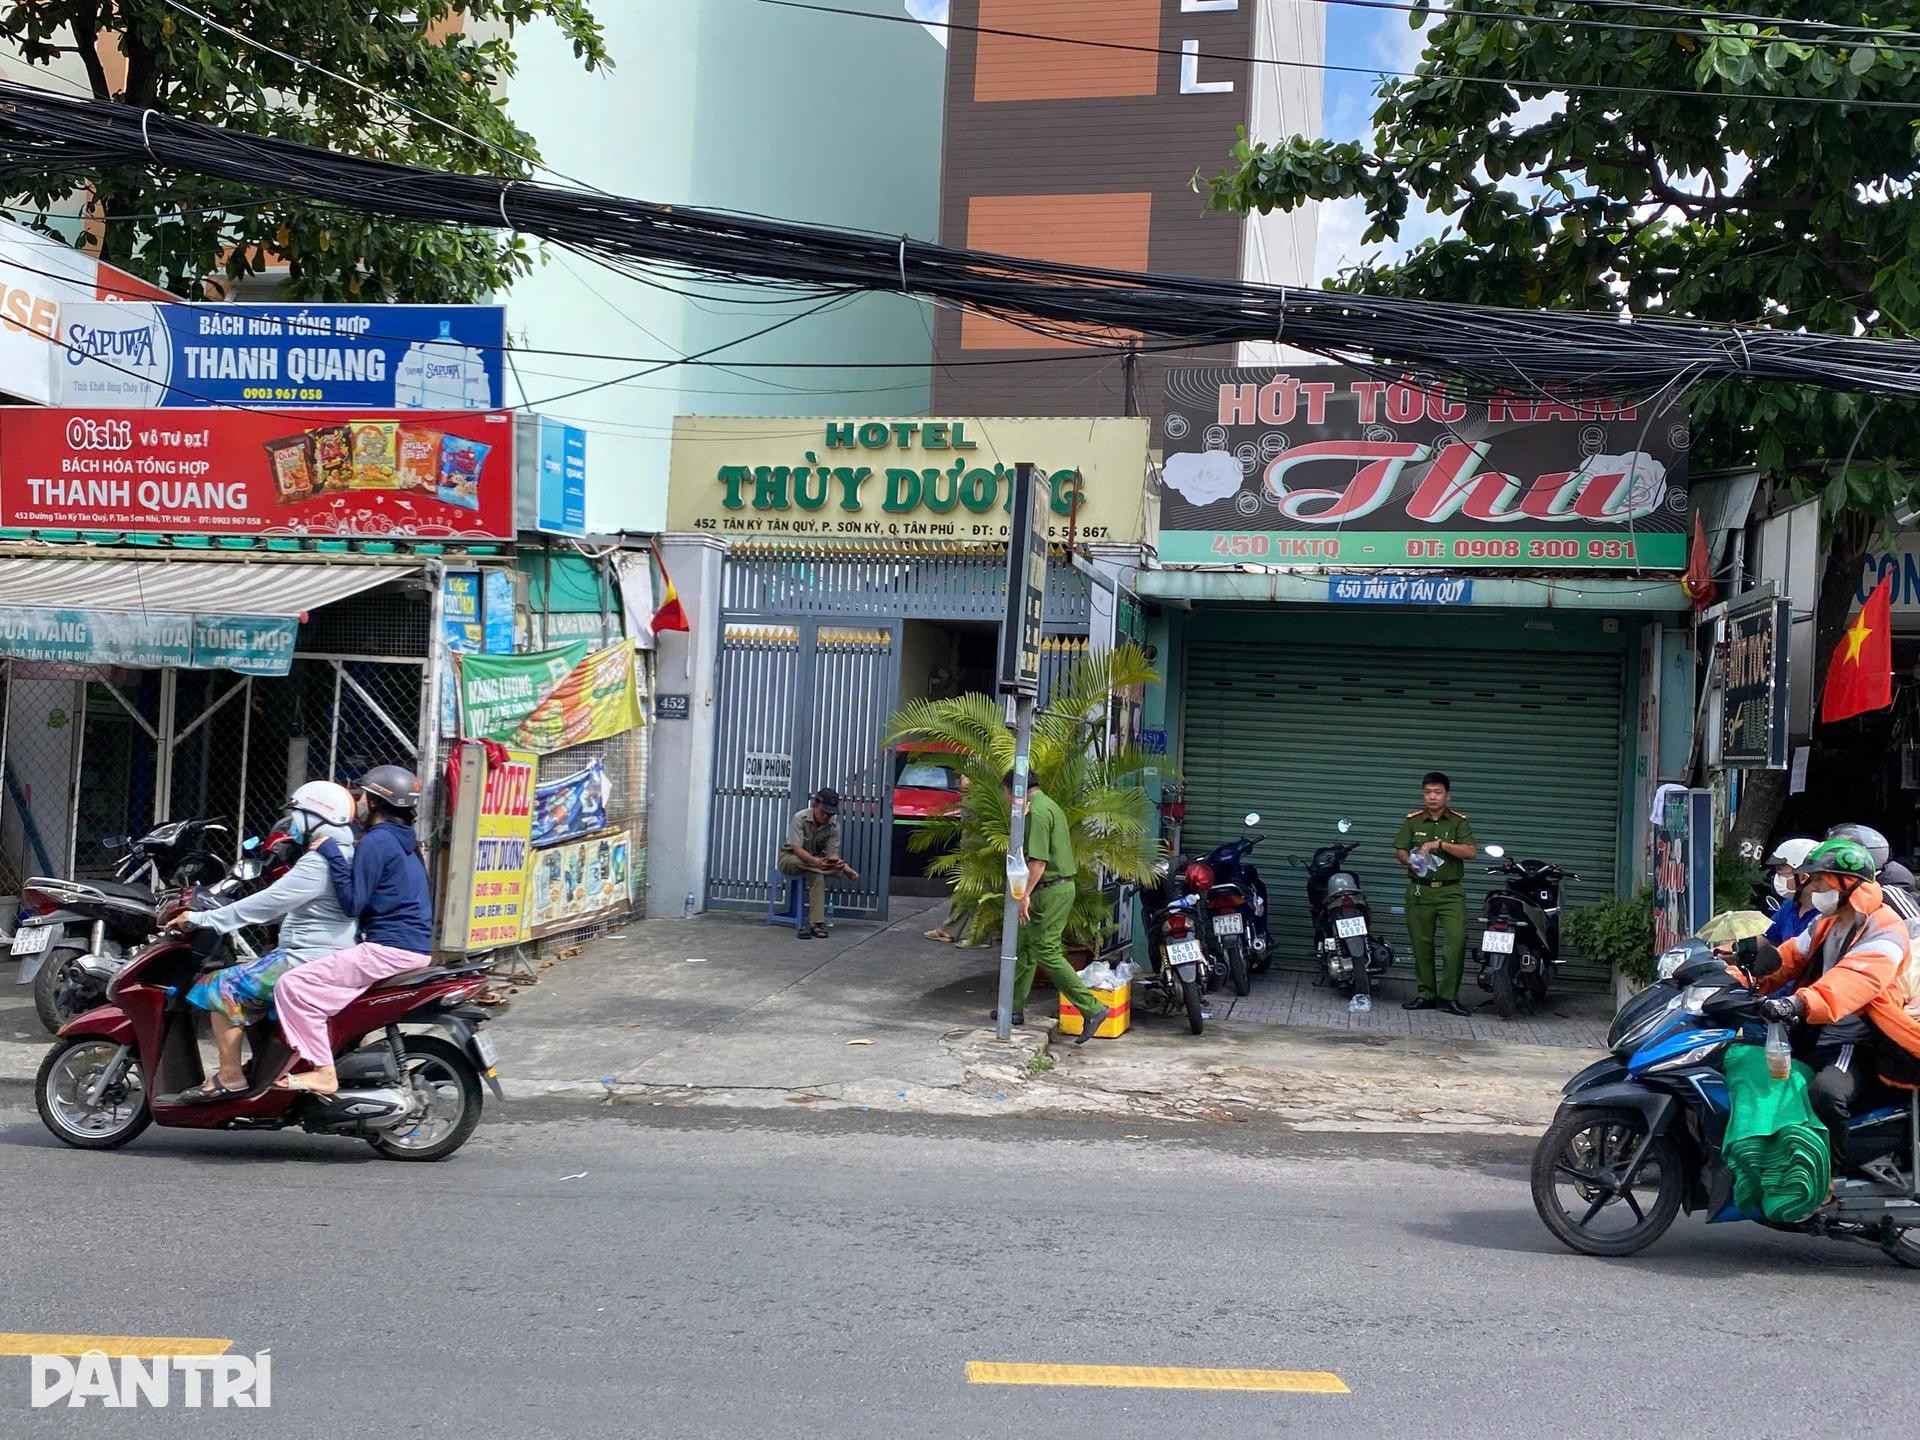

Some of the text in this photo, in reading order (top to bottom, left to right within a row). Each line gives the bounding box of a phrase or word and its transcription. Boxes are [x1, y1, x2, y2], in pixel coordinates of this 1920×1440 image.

[0, 281, 57, 343] SE
[200, 310, 371, 340] BÁCH HÓA TỔNG HỢP
[67, 323, 157, 366] SAPUWA
[184, 347, 386, 384] THANH QUANG
[243, 388, 323, 400] 0903 967 058
[1218, 374, 1334, 425] HỚT
[1352, 372, 1466, 424] TÓC
[66, 416, 132, 450] Oishi
[139, 428, 158, 446] VÔ
[826, 423, 977, 449] HOTEL
[62, 455, 209, 477] BÁCH HÓA TỔNG HỢP
[27, 479, 247, 510] THANH QUANG
[718, 451, 874, 512] THÙY
[1263, 440, 1656, 523] Thu
[14, 512, 28, 520] 452
[173, 515, 191, 523] HCM
[212, 516, 230, 524] 0903
[247, 517, 261, 525] 058
[694, 518, 716, 529] 452
[723, 518, 744, 530] TÂN
[747, 518, 763, 530] KỲ
[768, 519, 789, 531] TÂN
[792, 520, 818, 533] QUÝ,
[822, 523, 832, 532] P.
[837, 521, 861, 532] SƠN
[864, 522, 884, 534] KỲ,
[888, 523, 899, 534] Q.
[904, 521, 926, 534] TÂN
[930, 521, 954, 535] PHÚ
[972, 525, 993, 535] ĐT:
[1083, 526, 1108, 538] 867
[1212, 535, 1269, 556] 450
[1278, 539, 1339, 558] TKTQ
[1407, 539, 1445, 558] ĐT:
[1454, 539, 1520, 558] 0908
[1529, 540, 1579, 558] 300
[1588, 540, 1636, 559] 931
[1336, 580, 1361, 598] 450
[1363, 577, 1388, 599] TÂN
[1411, 579, 1434, 600] TÂN
[252, 629, 293, 656] HỢP
[660, 696, 686, 709] 452
[481, 766, 531, 816] HOTEL
[1739, 841, 1764, 860] 26
